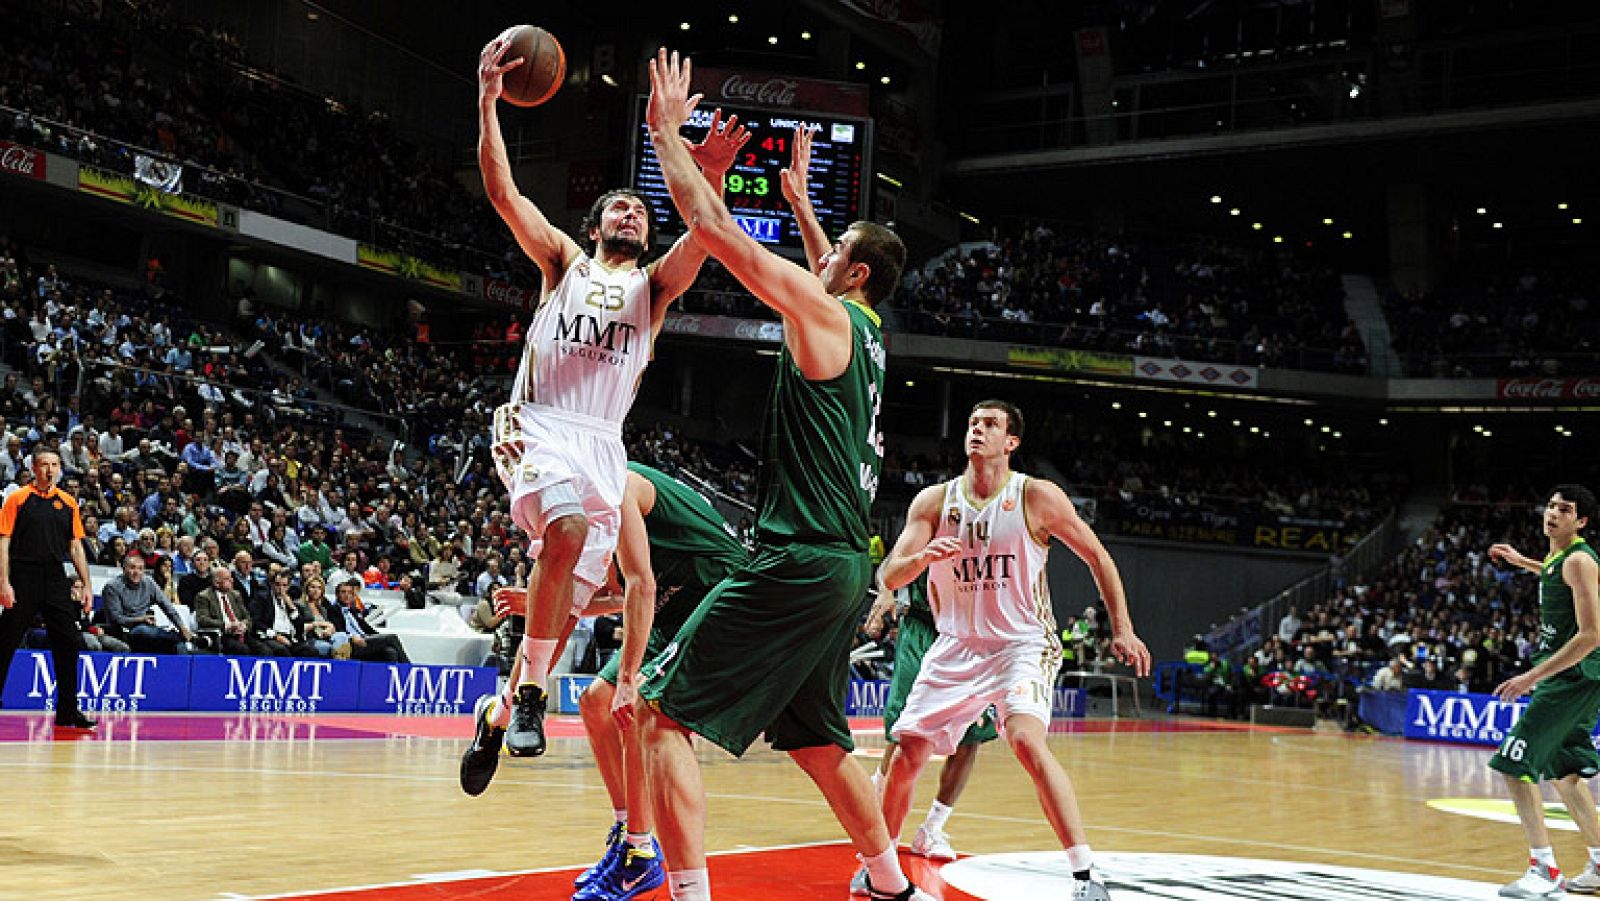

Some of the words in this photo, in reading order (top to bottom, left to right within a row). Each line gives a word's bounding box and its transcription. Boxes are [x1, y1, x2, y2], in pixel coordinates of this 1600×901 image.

[745, 153, 757, 166] 2
[761, 137, 785, 152] 41
[585, 280, 625, 311] 23
[553, 312, 636, 355] MMT
[966, 520, 989, 549] 14
[27, 652, 157, 699] MMT
[224, 658, 332, 700] MMT
[384, 664, 474, 704] MMT
[239, 699, 318, 712] SEGUROS
[1413, 693, 1530, 734] MMT
[1501, 736, 1527, 762] 16
